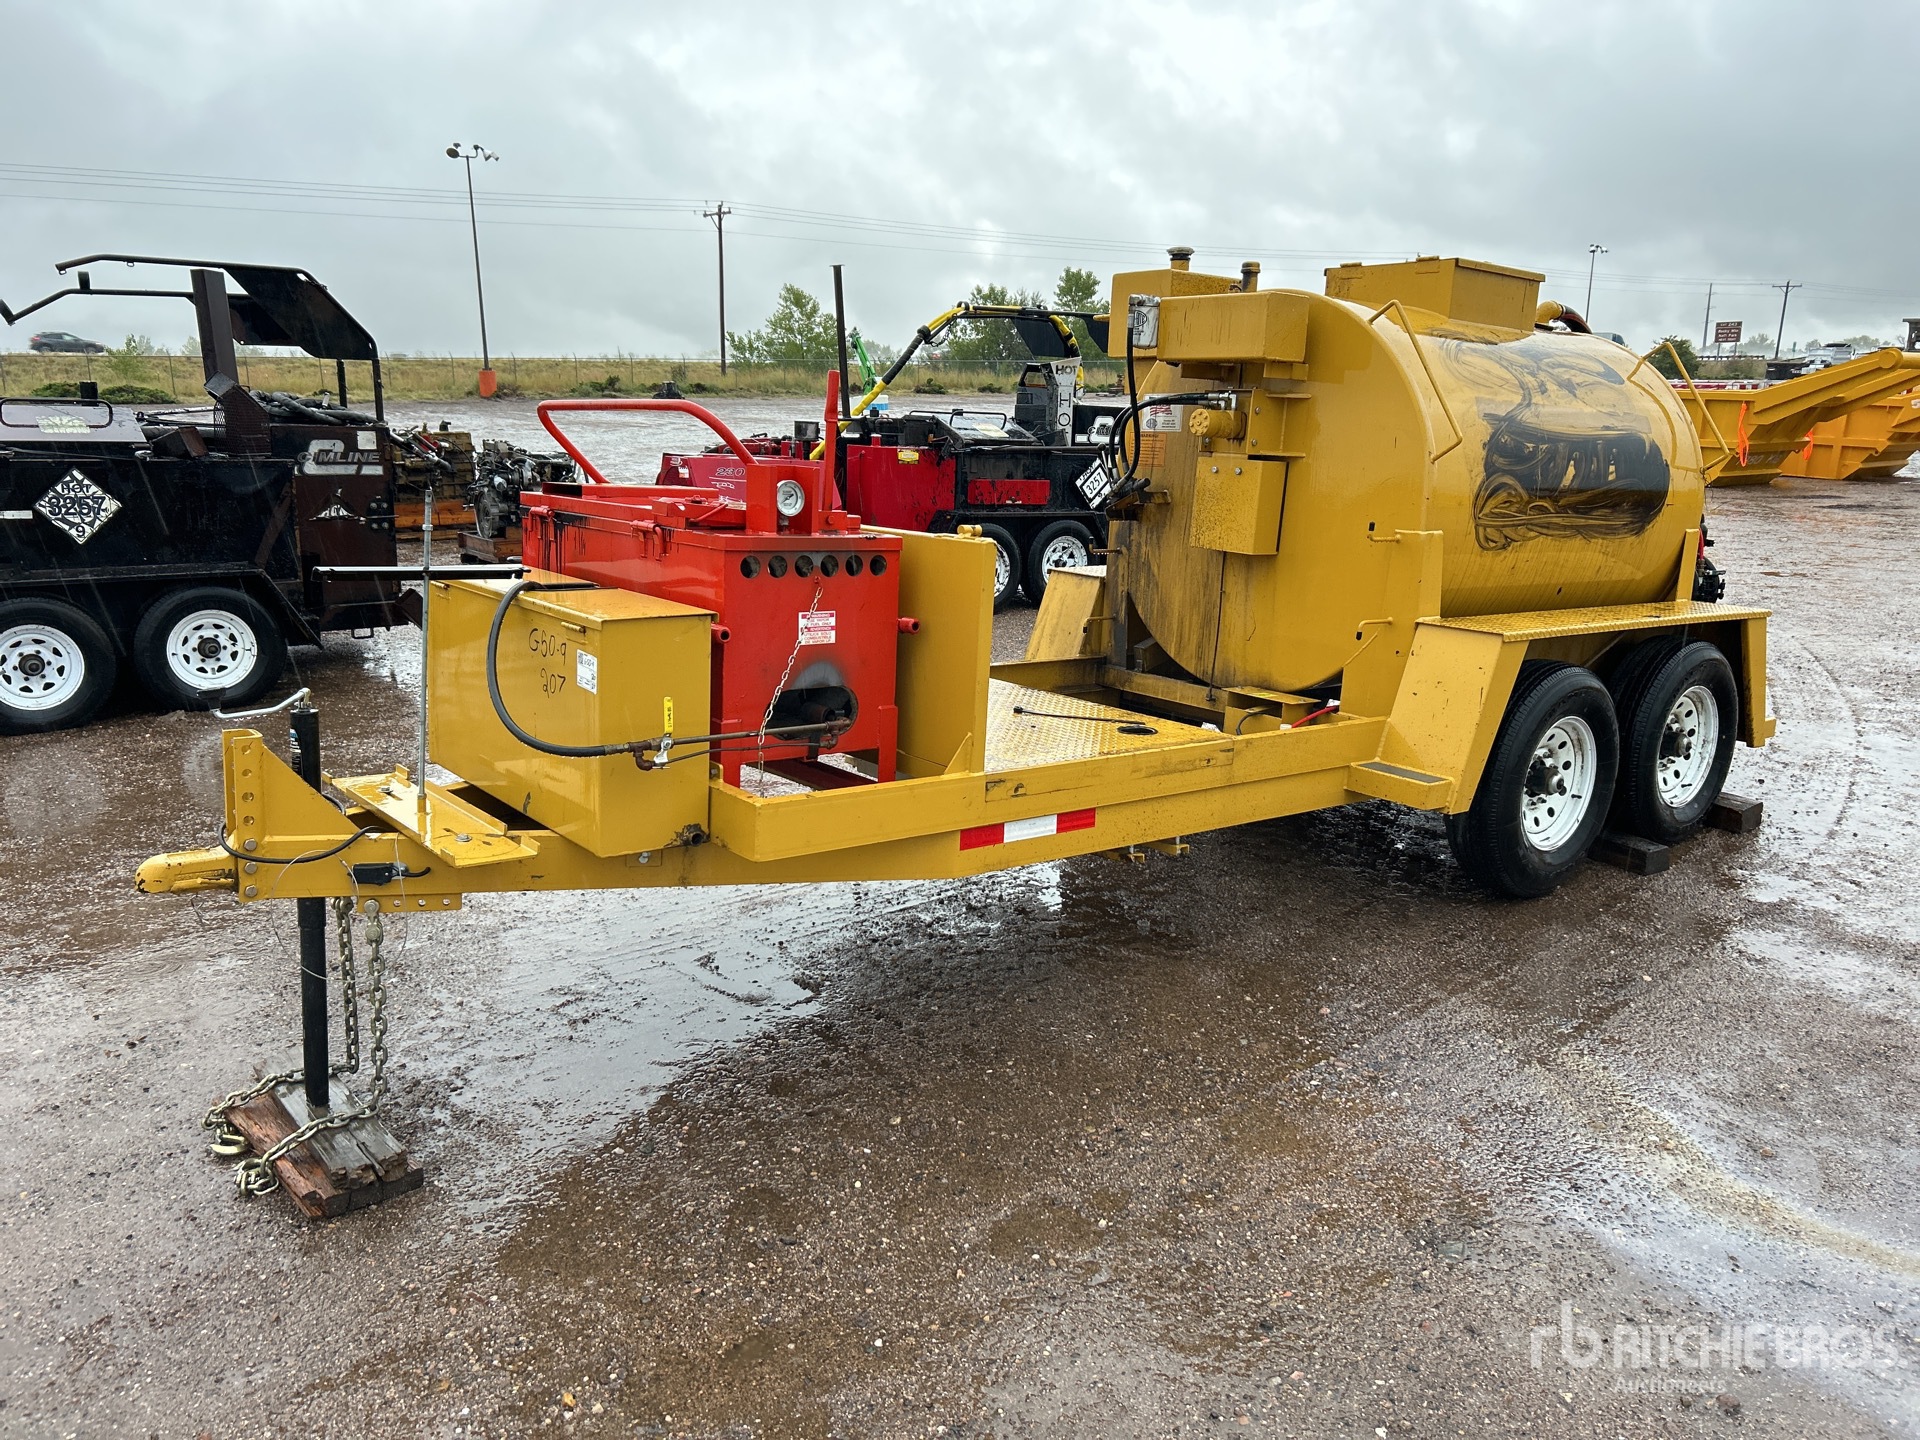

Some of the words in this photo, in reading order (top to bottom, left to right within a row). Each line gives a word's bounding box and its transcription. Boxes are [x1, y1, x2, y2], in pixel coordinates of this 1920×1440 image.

[1055, 365, 1078, 375] HOT
[297, 451, 381, 463] CIMLINE
[715, 466, 746, 477] 230
[61, 483, 92, 494] HOT
[1085, 471, 1104, 495] 3257
[47, 496, 106, 517] 3257
[75, 525, 86, 538] 9
[540, 667, 567, 699] 207
